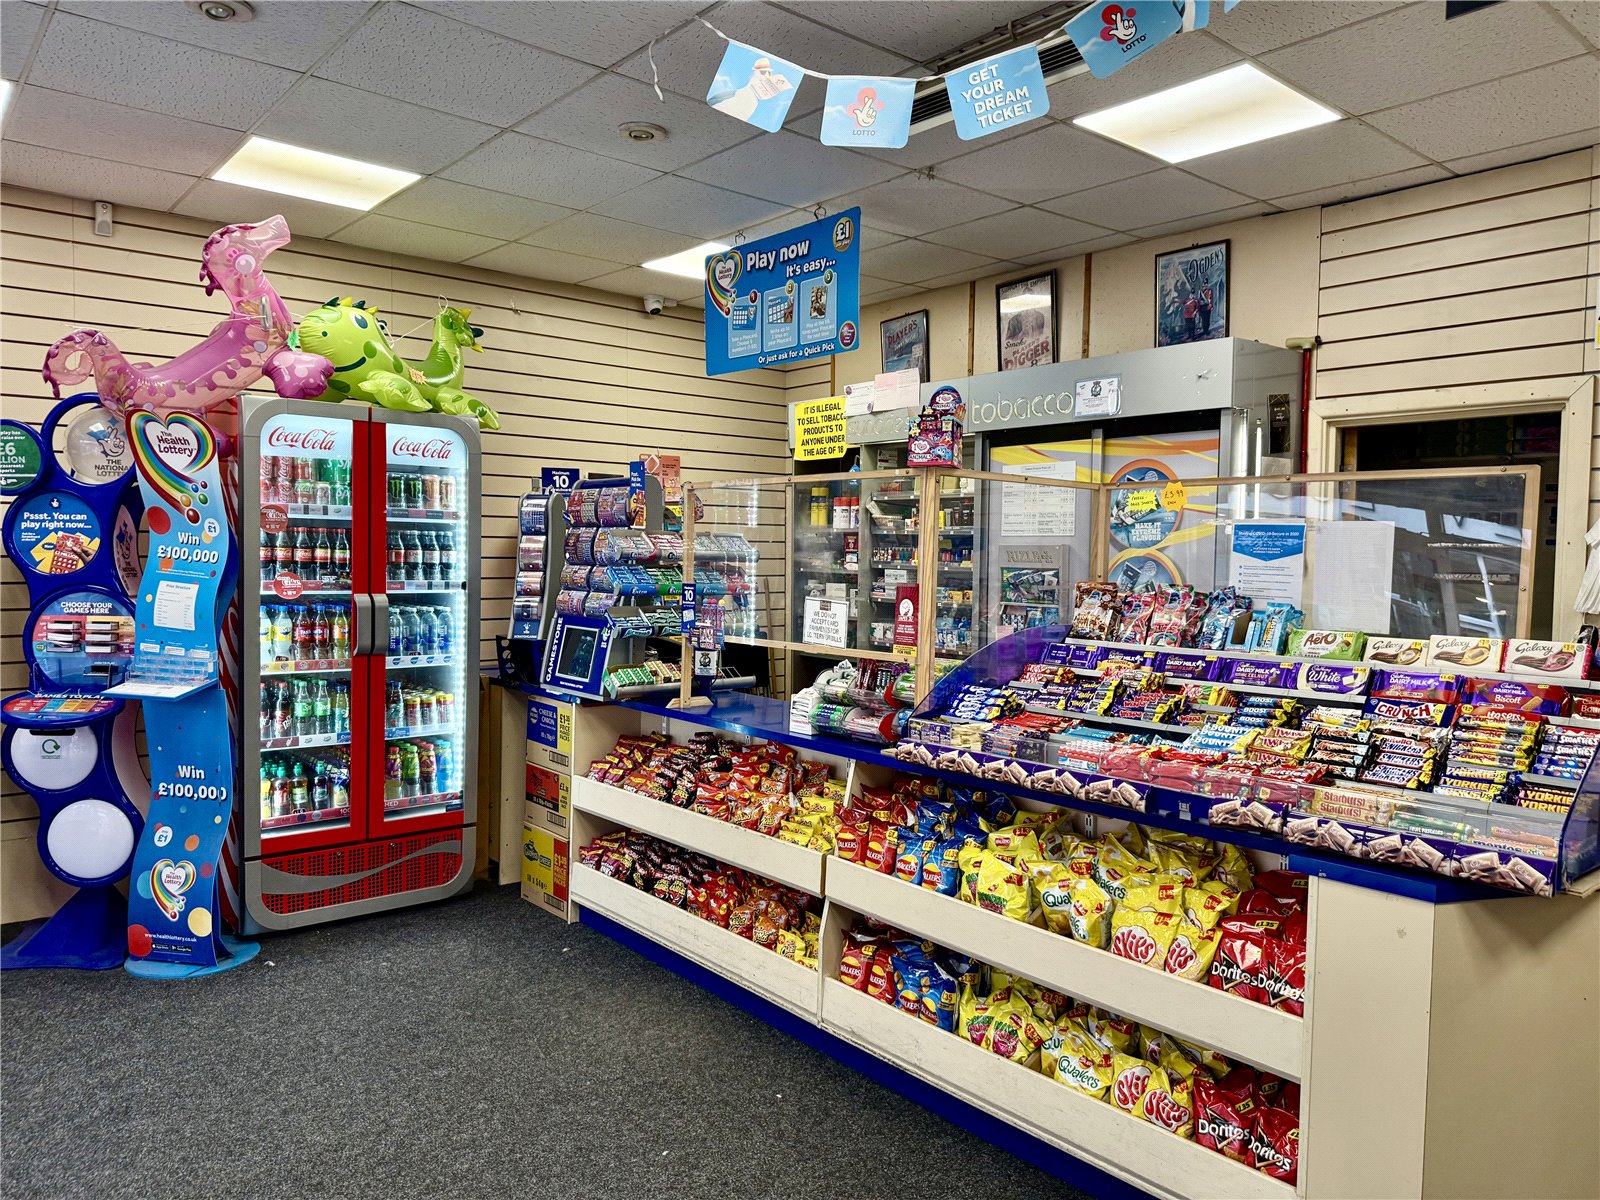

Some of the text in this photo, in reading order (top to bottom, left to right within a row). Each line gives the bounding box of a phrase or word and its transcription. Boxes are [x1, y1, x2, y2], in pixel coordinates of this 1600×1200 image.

[1121, 34, 1147, 53] LOTTO
[968, 65, 998, 85] GET
[961, 80, 1005, 103] YOUR
[974, 86, 1030, 115] DREAM
[977, 101, 1033, 128] TICKET
[852, 129, 876, 137] LOTTO
[836, 221, 850, 241] £1
[746, 240, 810, 272] Play now
[786, 258, 836, 278] It's easy...
[1187, 246, 1224, 282] OGDEN'S
[766, 354, 777, 364] just
[804, 345, 821, 356] Quick
[822, 343, 835, 352] Pick
[816, 402, 841, 413] ILLEGAL
[971, 390, 1075, 424] tobacco
[806, 414, 820, 424] SELL
[803, 425, 833, 436] PRODUCTS
[157, 435, 191, 446] Health
[801, 435, 845, 446] ANYONE UNDER
[158, 444, 194, 457] Lottery
[803, 448, 815, 457] THE
[553, 475, 569, 488] 10
[24, 512, 51, 520] Pssst.
[53, 512, 70, 520] You
[21, 521, 40, 530] play
[42, 520, 64, 530] right
[178, 533, 200, 546] Win
[157, 545, 219, 564] £100,000
[60, 601, 91, 609] CHOOSE
[63, 606, 88, 614] GAMES
[545, 617, 564, 682] GAMESTORE
[1373, 641, 1404, 653] Galaxy
[1436, 638, 1471, 652] Galaxy
[1515, 642, 1554, 656] Galaxy
[1308, 669, 1341, 684] White
[1495, 695, 1521, 704] Biscoff
[1377, 702, 1430, 718] CRUNCH
[178, 765, 205, 779] Win
[1212, 962, 1258, 985] Doritos
[1058, 1055, 1100, 1089] Quavers
[1198, 1119, 1250, 1140] Doritos
